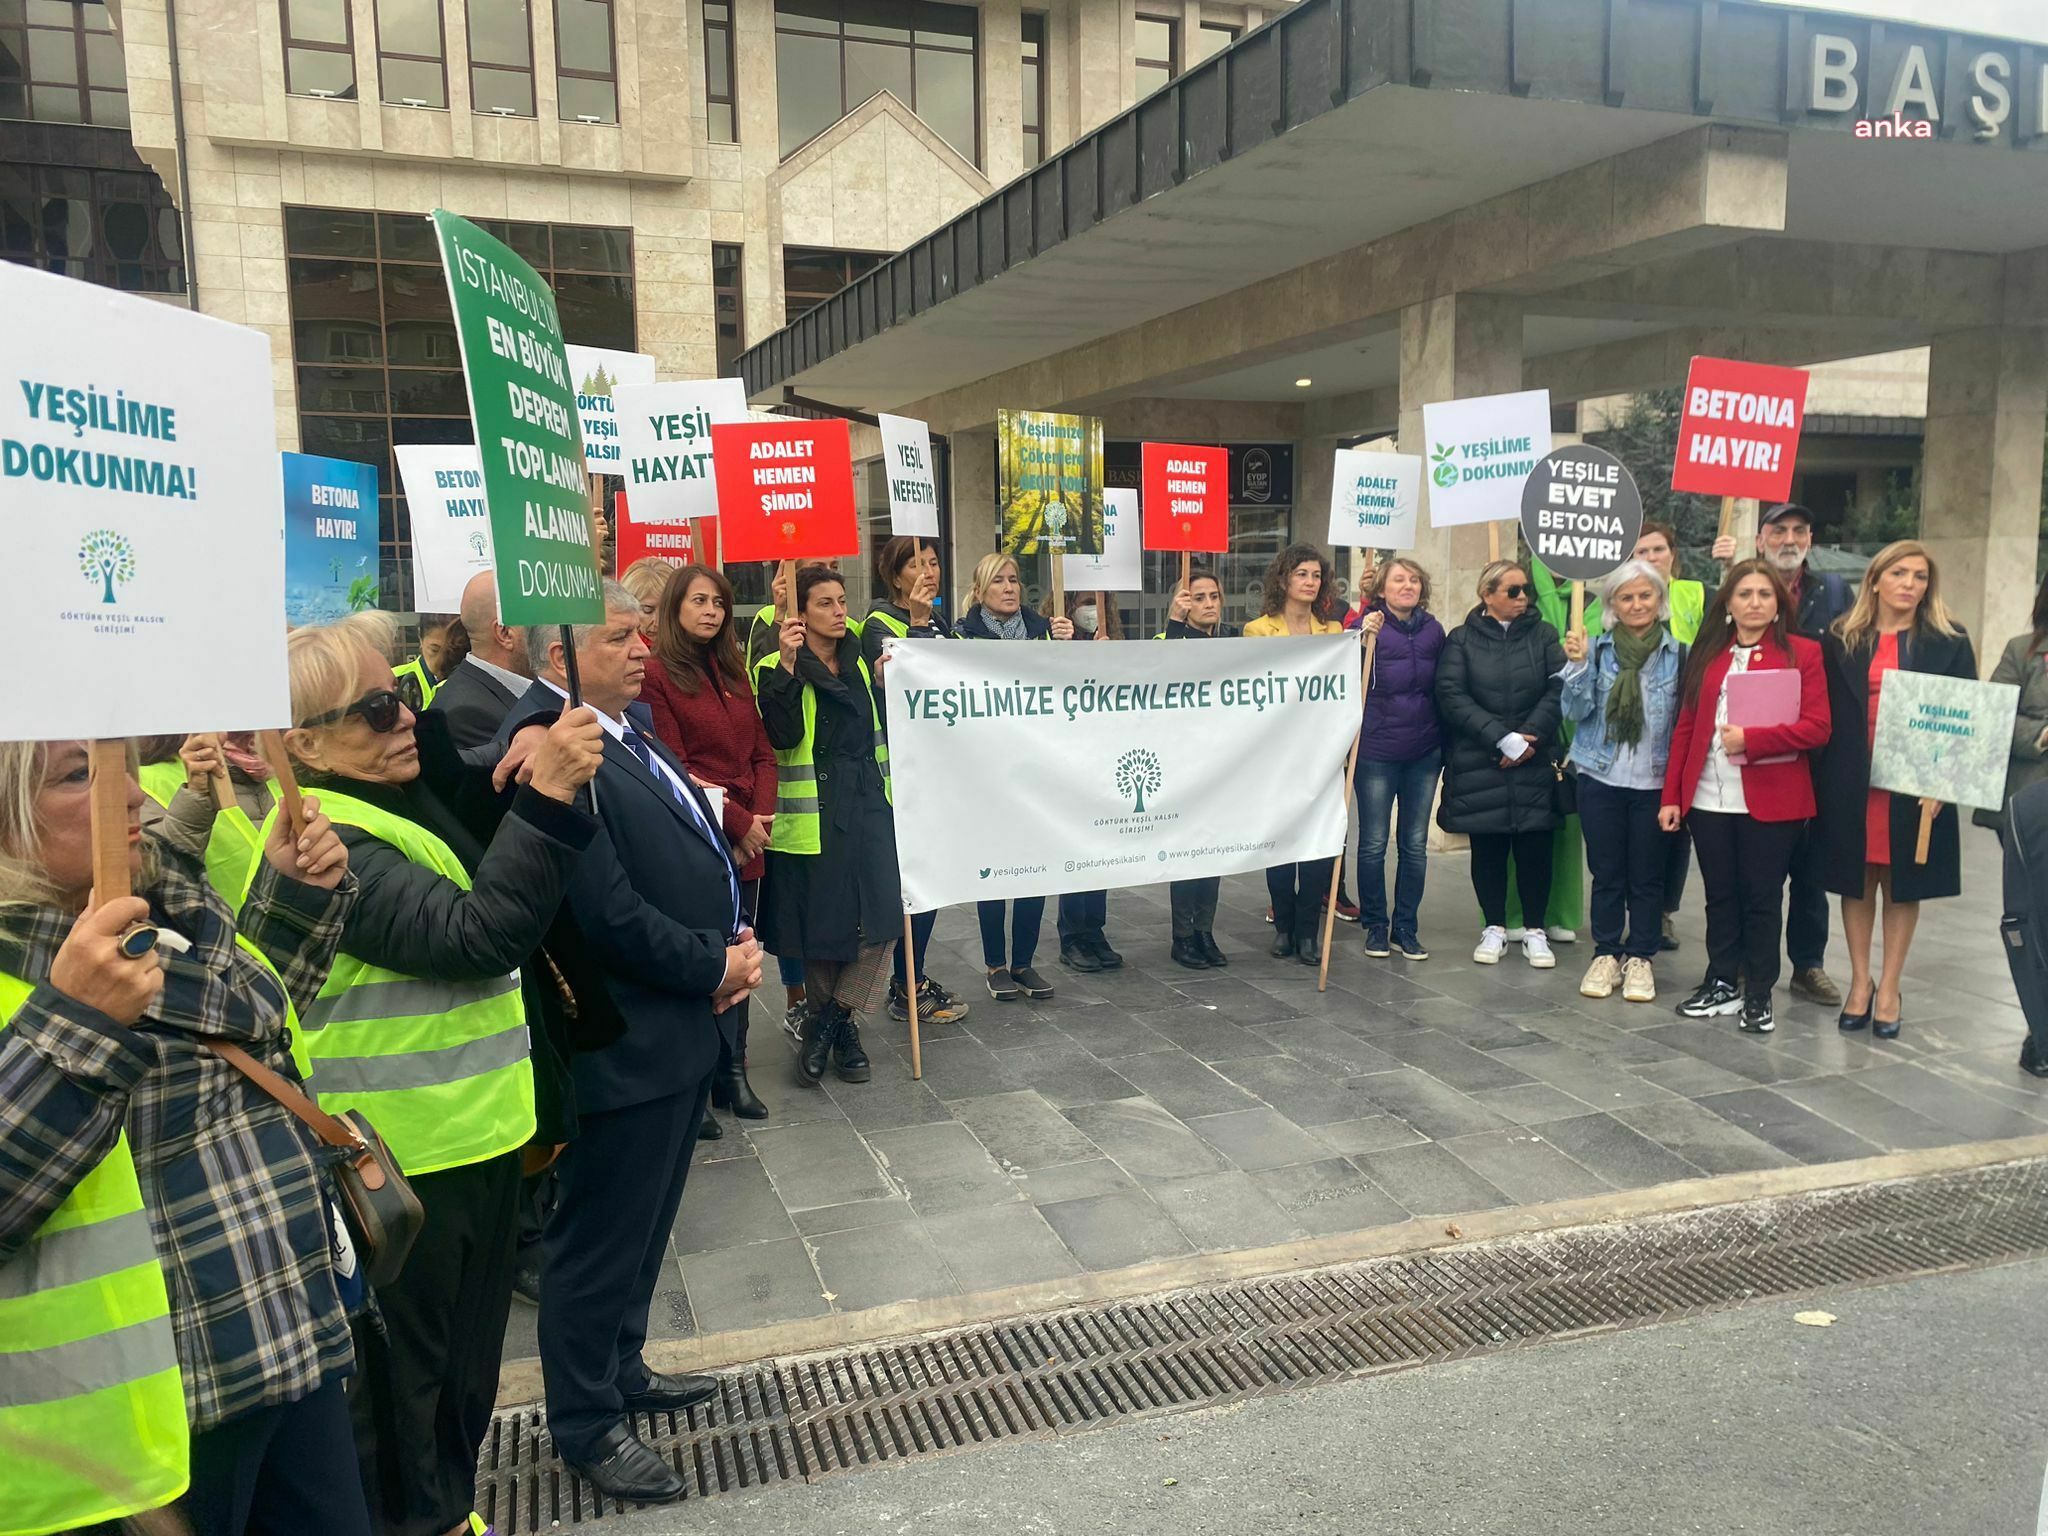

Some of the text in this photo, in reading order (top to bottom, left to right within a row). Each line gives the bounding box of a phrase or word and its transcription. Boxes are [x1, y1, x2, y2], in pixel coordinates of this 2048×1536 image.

[486, 316, 568, 390] EN BÜYÜK
[19, 380, 177, 442] YEŞİLİME
[507, 381, 572, 440] DEPREM
[576, 391, 615, 413] ÖKTÜ
[1689, 387, 1795, 428] BETONA
[750, 440, 814, 459] ADALET
[897, 441, 924, 474] YEŞİL
[1461, 436, 1532, 461] YEŞİLİME
[1689, 433, 1782, 473] HAYIR!
[2, 439, 197, 501] DOKUNMA!
[434, 470, 482, 488] BETON
[501, 437, 588, 496] TOPLANMA
[632, 453, 714, 484] HAYAT
[753, 466, 816, 485] HEMEN
[1166, 460, 1208, 475] ADALET
[1462, 459, 1539, 482] DOKUNM
[1547, 459, 1619, 483] YEŞİLE
[892, 477, 935, 505] NEFESTİR
[1167, 480, 1207, 495] HEMEN
[1357, 475, 1398, 490] ADALET
[1548, 482, 1617, 508] EVET
[311, 484, 360, 509] BETONA
[761, 489, 813, 516] ŞİMDİ
[1171, 498, 1204, 518] ŞİMDİ
[1356, 494, 1395, 508] HEMEN
[316, 517, 357, 540] HAYIR!
[525, 501, 590, 547] ALANINA
[1358, 512, 1391, 527] ŞİMDİ
[1538, 510, 1624, 535] BETONA
[645, 533, 691, 549] HEMEN
[1538, 534, 1622, 560] HAYIR!
[904, 671, 1345, 727] YEŞİLİMİZE ÇÖKENLERE GEÇİT YOK!
[1908, 718, 1975, 737] DOKUNMA!
[992, 864, 1047, 878] yesilgokturk
[1076, 853, 1146, 871] gokturkyesilkalsin
